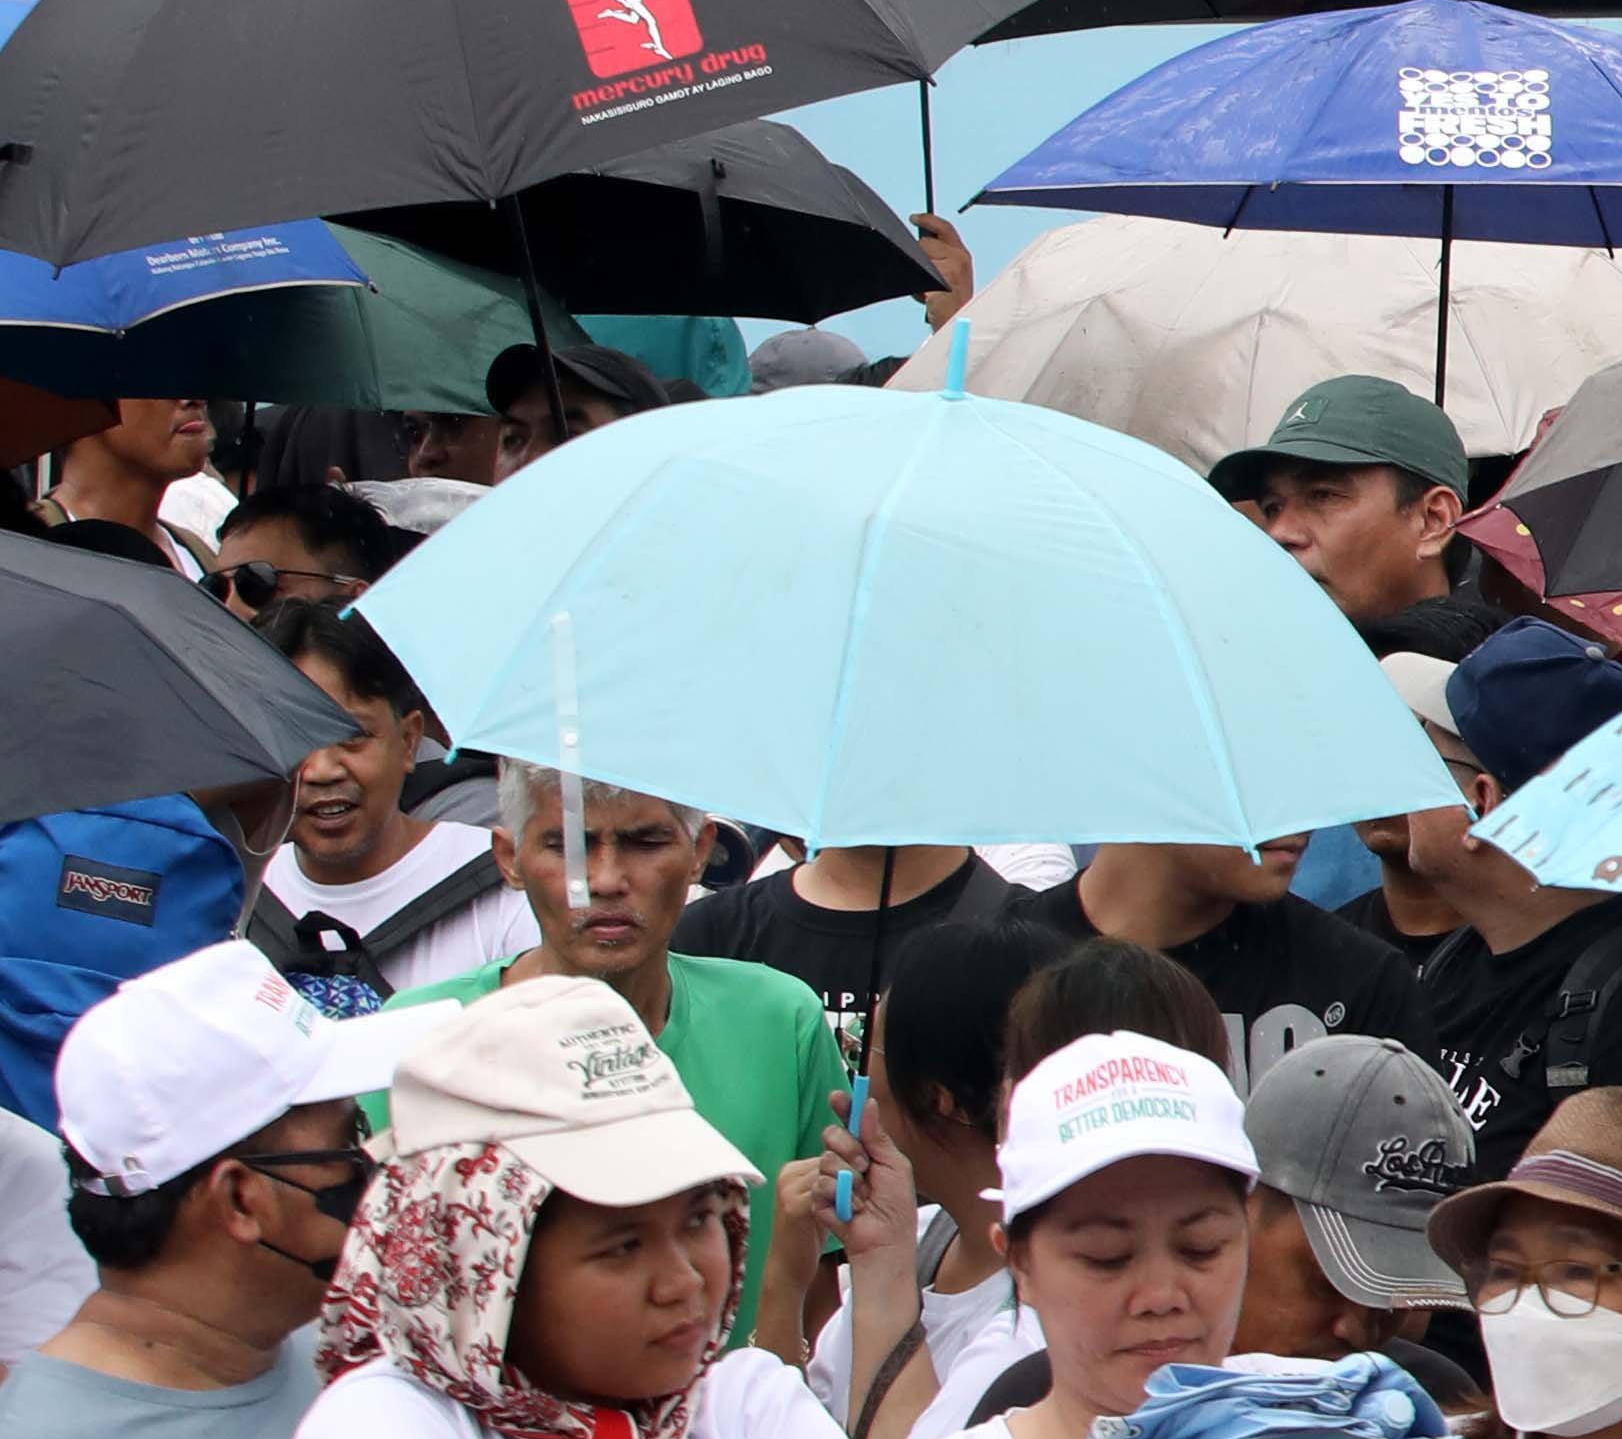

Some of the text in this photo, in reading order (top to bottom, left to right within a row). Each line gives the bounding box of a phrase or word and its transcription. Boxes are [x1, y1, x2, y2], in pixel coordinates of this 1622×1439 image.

[570, 42, 768, 112] mercury drug
[581, 65, 773, 127] NAKASISIGURO GAMOT AY LAGING BAGO
[1400, 91, 1551, 110] YES TO
[1415, 105, 1537, 118] mentos
[1399, 110, 1552, 136] FRESH
[63, 871, 153, 906] JANSPORT
[1053, 1056, 1190, 1110] TRANSPARENCY
[1058, 1097, 1198, 1144] BETTER DEMOCRACY
